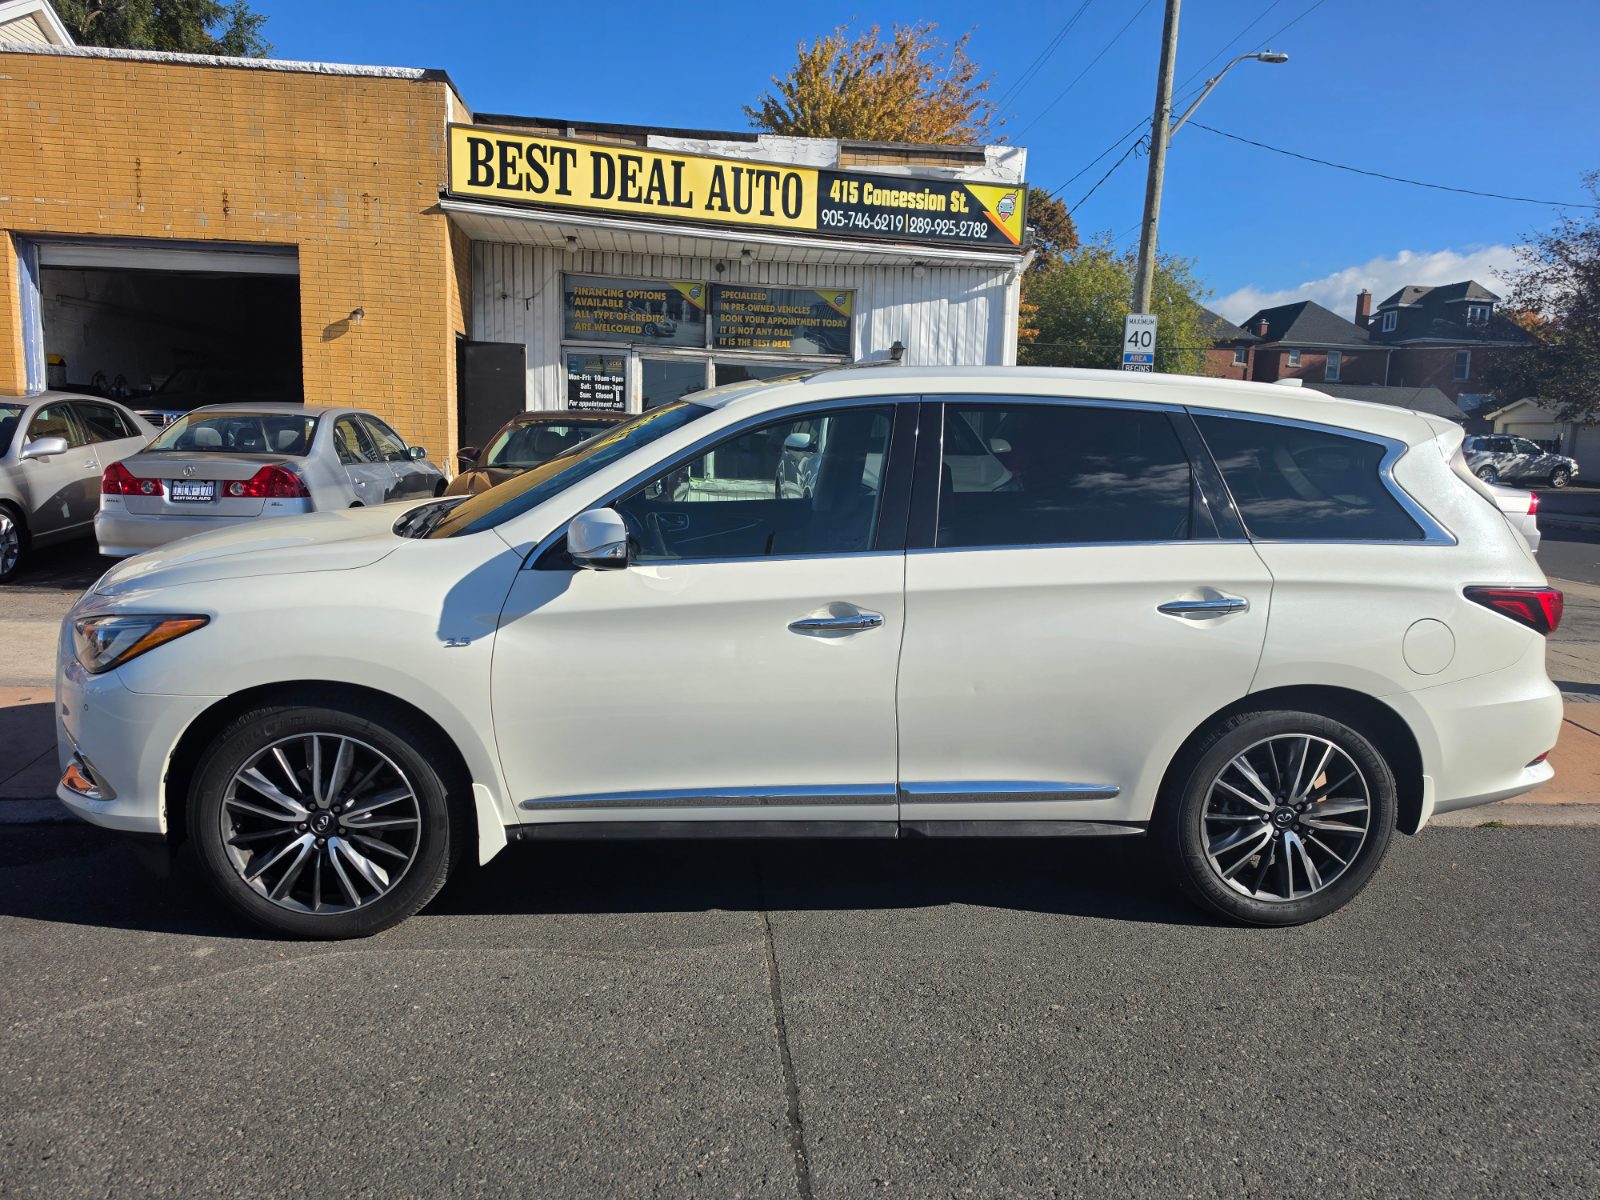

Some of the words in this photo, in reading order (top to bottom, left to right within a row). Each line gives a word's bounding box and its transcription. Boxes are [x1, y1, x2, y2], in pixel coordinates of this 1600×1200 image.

[467, 136, 577, 196] BEST
[590, 150, 693, 209] DEAL
[705, 164, 803, 219] AUTO
[829, 179, 859, 204] 415
[863, 182, 946, 212] Concession
[950, 190, 970, 213] St.
[821, 209, 904, 232] 905-746-6219
[909, 216, 988, 239] 289-925-2782
[573, 286, 624, 298] FINANCING
[626, 290, 667, 300] OPTIONS
[720, 290, 767, 301] SPECIALIZED
[574, 297, 624, 308] AVAILABLE
[720, 302, 730, 311] IN
[731, 303, 776, 313] PRE-OWNED
[777, 305, 811, 315] VEHICLES
[574, 309, 591, 319] ALL
[593, 310, 614, 320] TYPE
[616, 311, 628, 320] OF
[630, 312, 665, 323] CREDITS
[720, 313, 743, 323] BOOK
[745, 315, 766, 324] YOUR
[767, 316, 821, 327] APPOINTMENT
[822, 318, 848, 328] TODAY
[574, 322, 592, 331] ARE
[594, 323, 642, 334] WELCOMED
[720, 326, 727, 334] IT
[728, 326, 736, 334] IS
[737, 326, 754, 335] NOT
[755, 327, 772, 336] ANY
[720, 337, 727, 345] IT
[728, 338, 736, 346] IS
[737, 338, 751, 347] THE
[753, 339, 770, 347] BEST
[772, 339, 792, 348] DEAL
[1127, 330, 1152, 348] 40
[568, 373, 592, 381] Mon-Fri:
[594, 375, 624, 383] 10am-6pm
[580, 382, 592, 390] Sat:
[594, 383, 624, 391] 10am-3pm
[579, 391, 592, 399] Sun:
[568, 399, 578, 407] For
